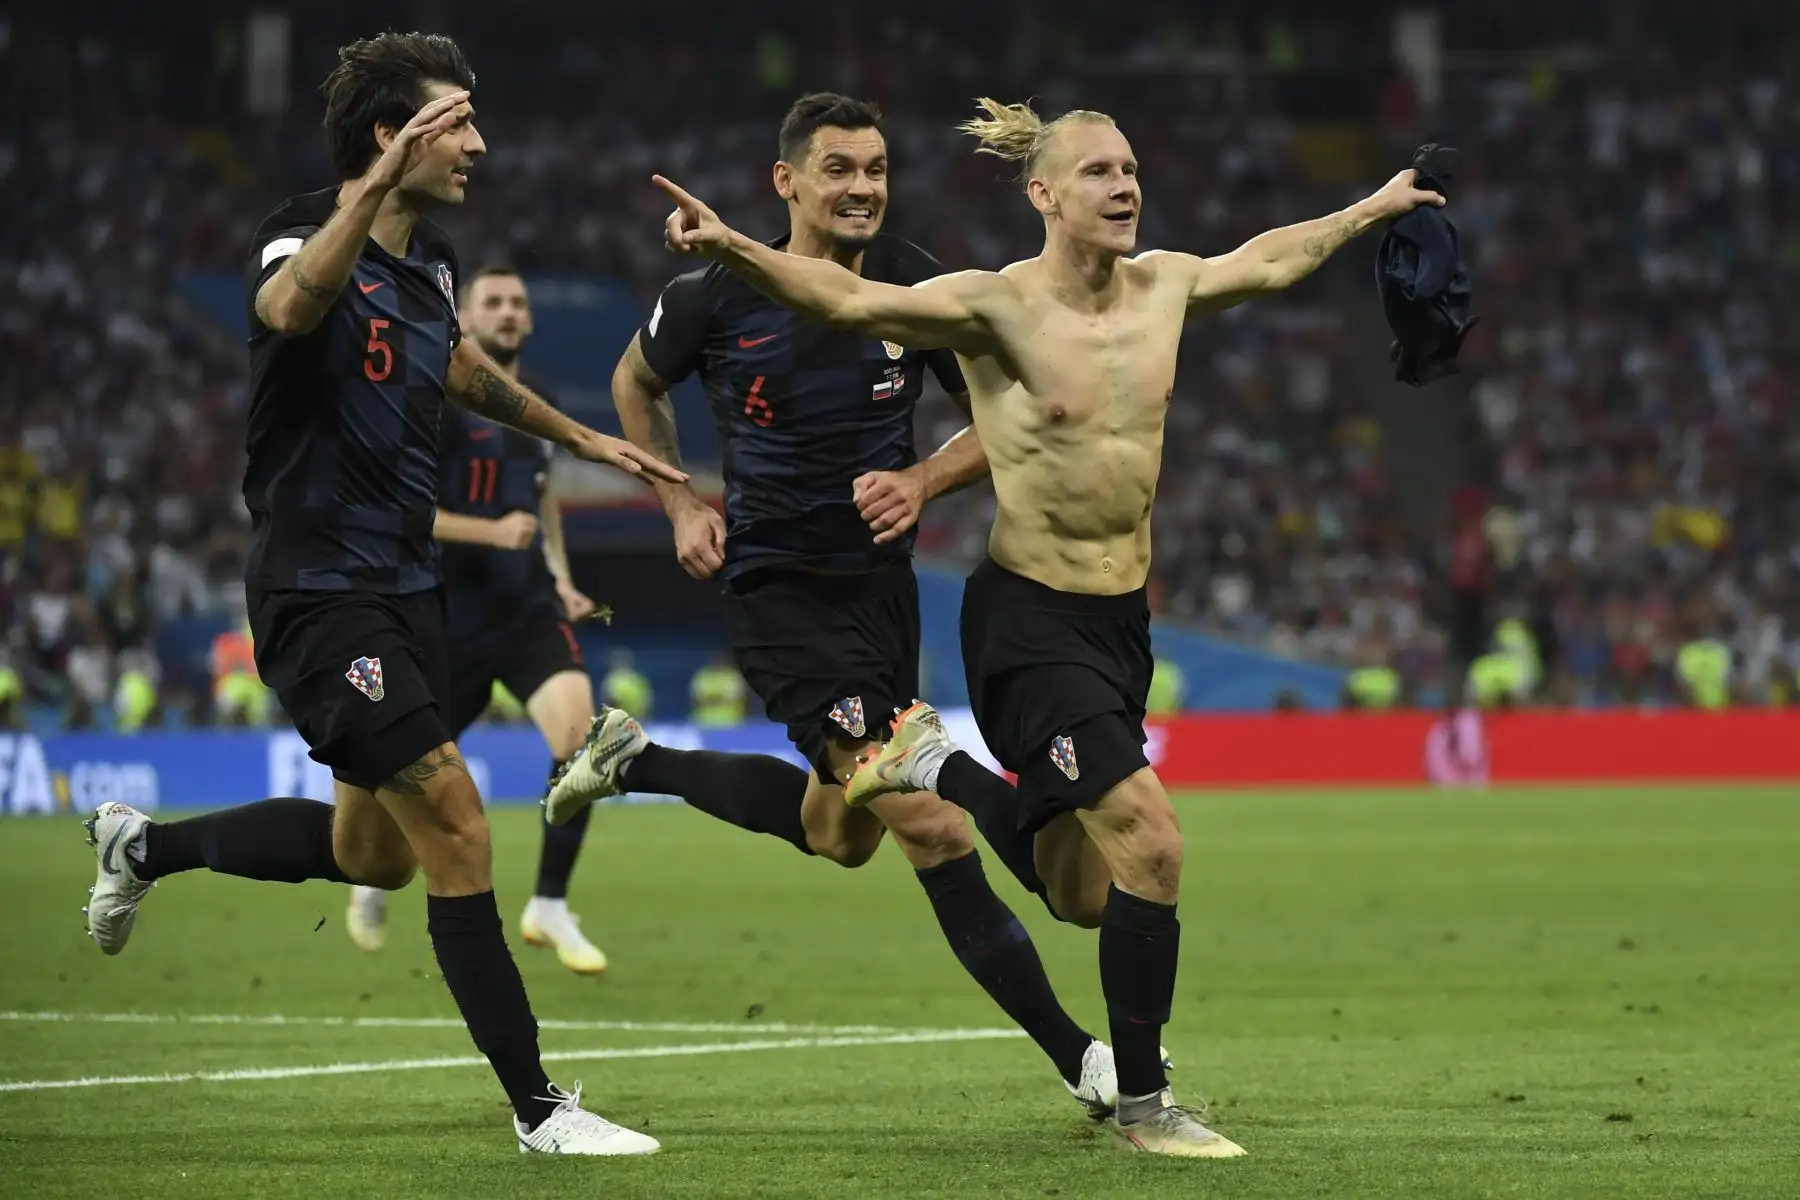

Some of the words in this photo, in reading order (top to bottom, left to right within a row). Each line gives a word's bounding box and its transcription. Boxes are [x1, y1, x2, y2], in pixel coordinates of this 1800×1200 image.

[364, 318, 393, 382] 5
[745, 375, 773, 427] 6
[468, 458, 496, 504] 11
